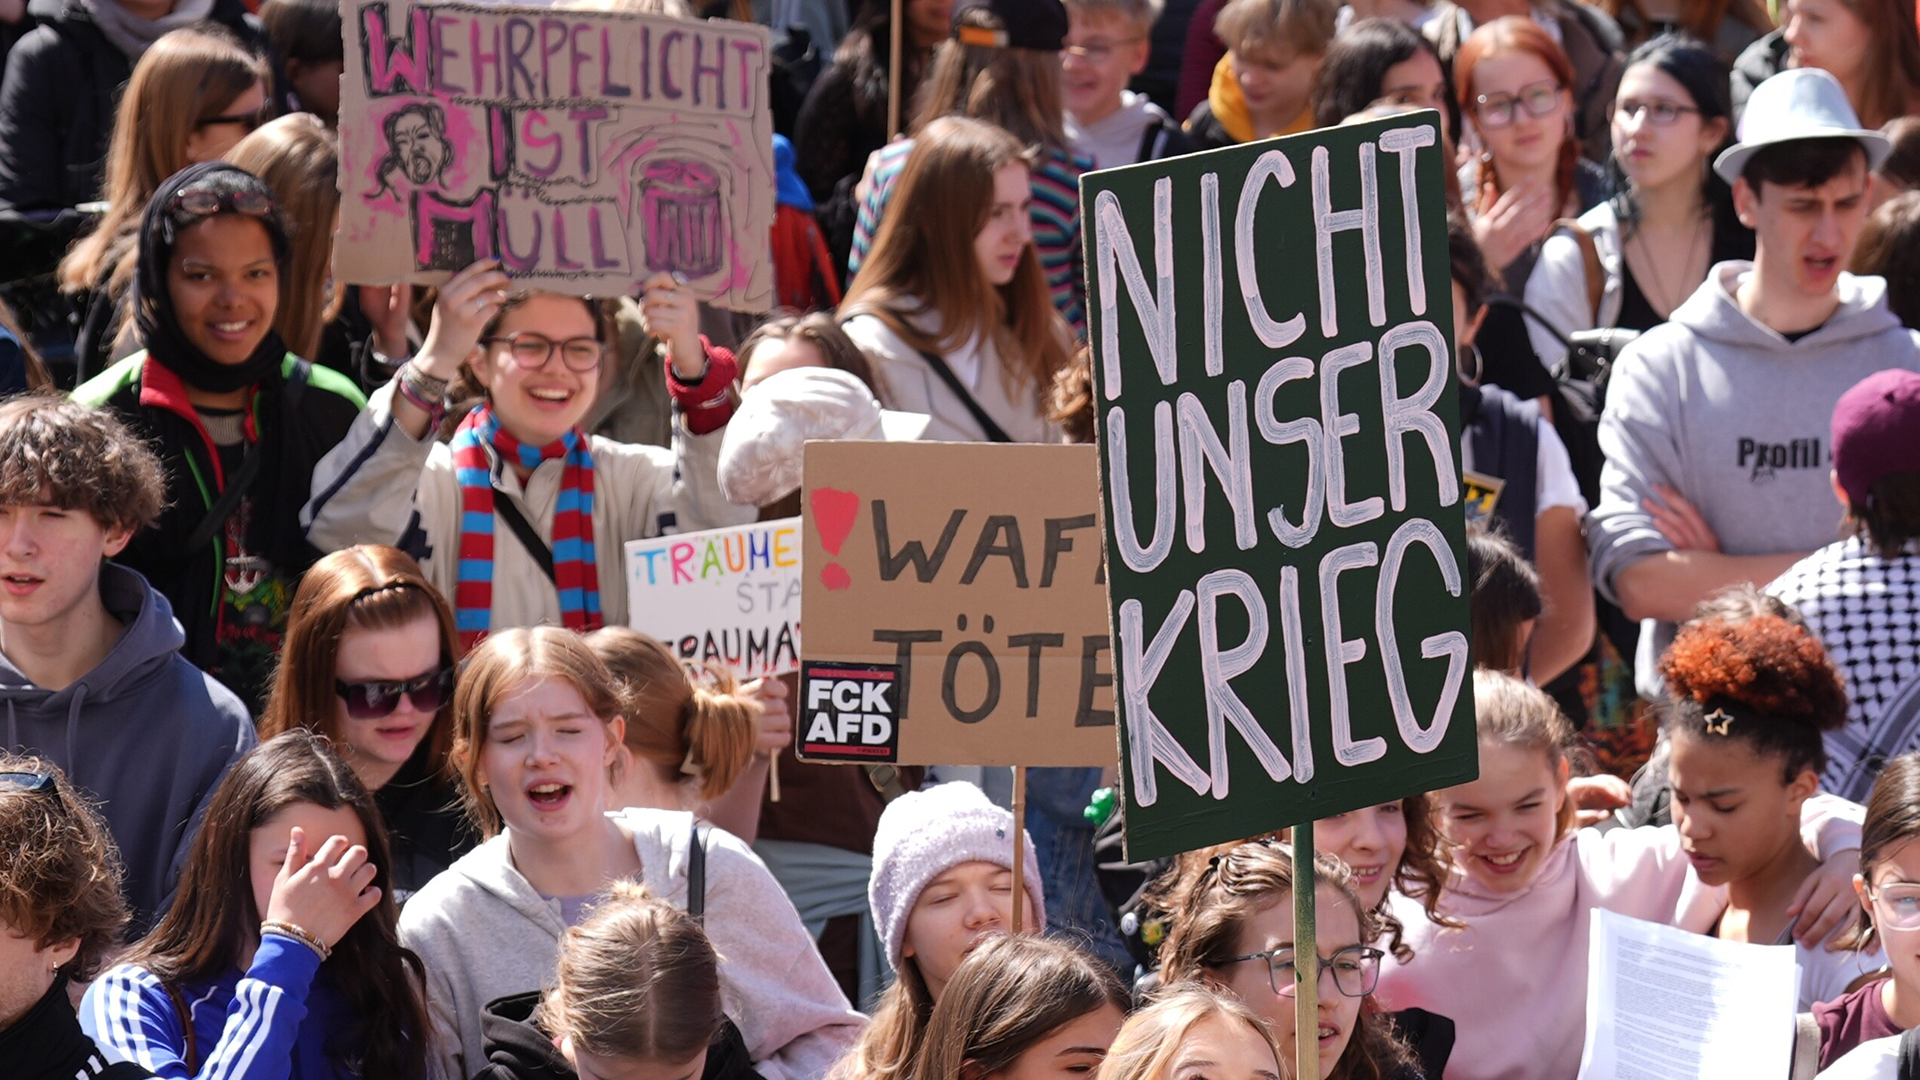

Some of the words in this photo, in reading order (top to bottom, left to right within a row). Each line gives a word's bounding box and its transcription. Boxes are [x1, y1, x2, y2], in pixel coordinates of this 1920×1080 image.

[360, 3, 762, 110] WEHRPFLICHT
[487, 106, 608, 182] IST
[410, 186, 621, 272] MÜLL
[1095, 124, 1436, 400] NICHT
[1107, 320, 1459, 573] UNSER
[1737, 437, 1820, 469] Profil
[635, 528, 798, 586] TRÄUME
[871, 500, 1107, 589] WAF
[808, 679, 892, 713] FCK
[1119, 518, 1469, 807] KRIEG
[805, 711, 892, 745] AFD
